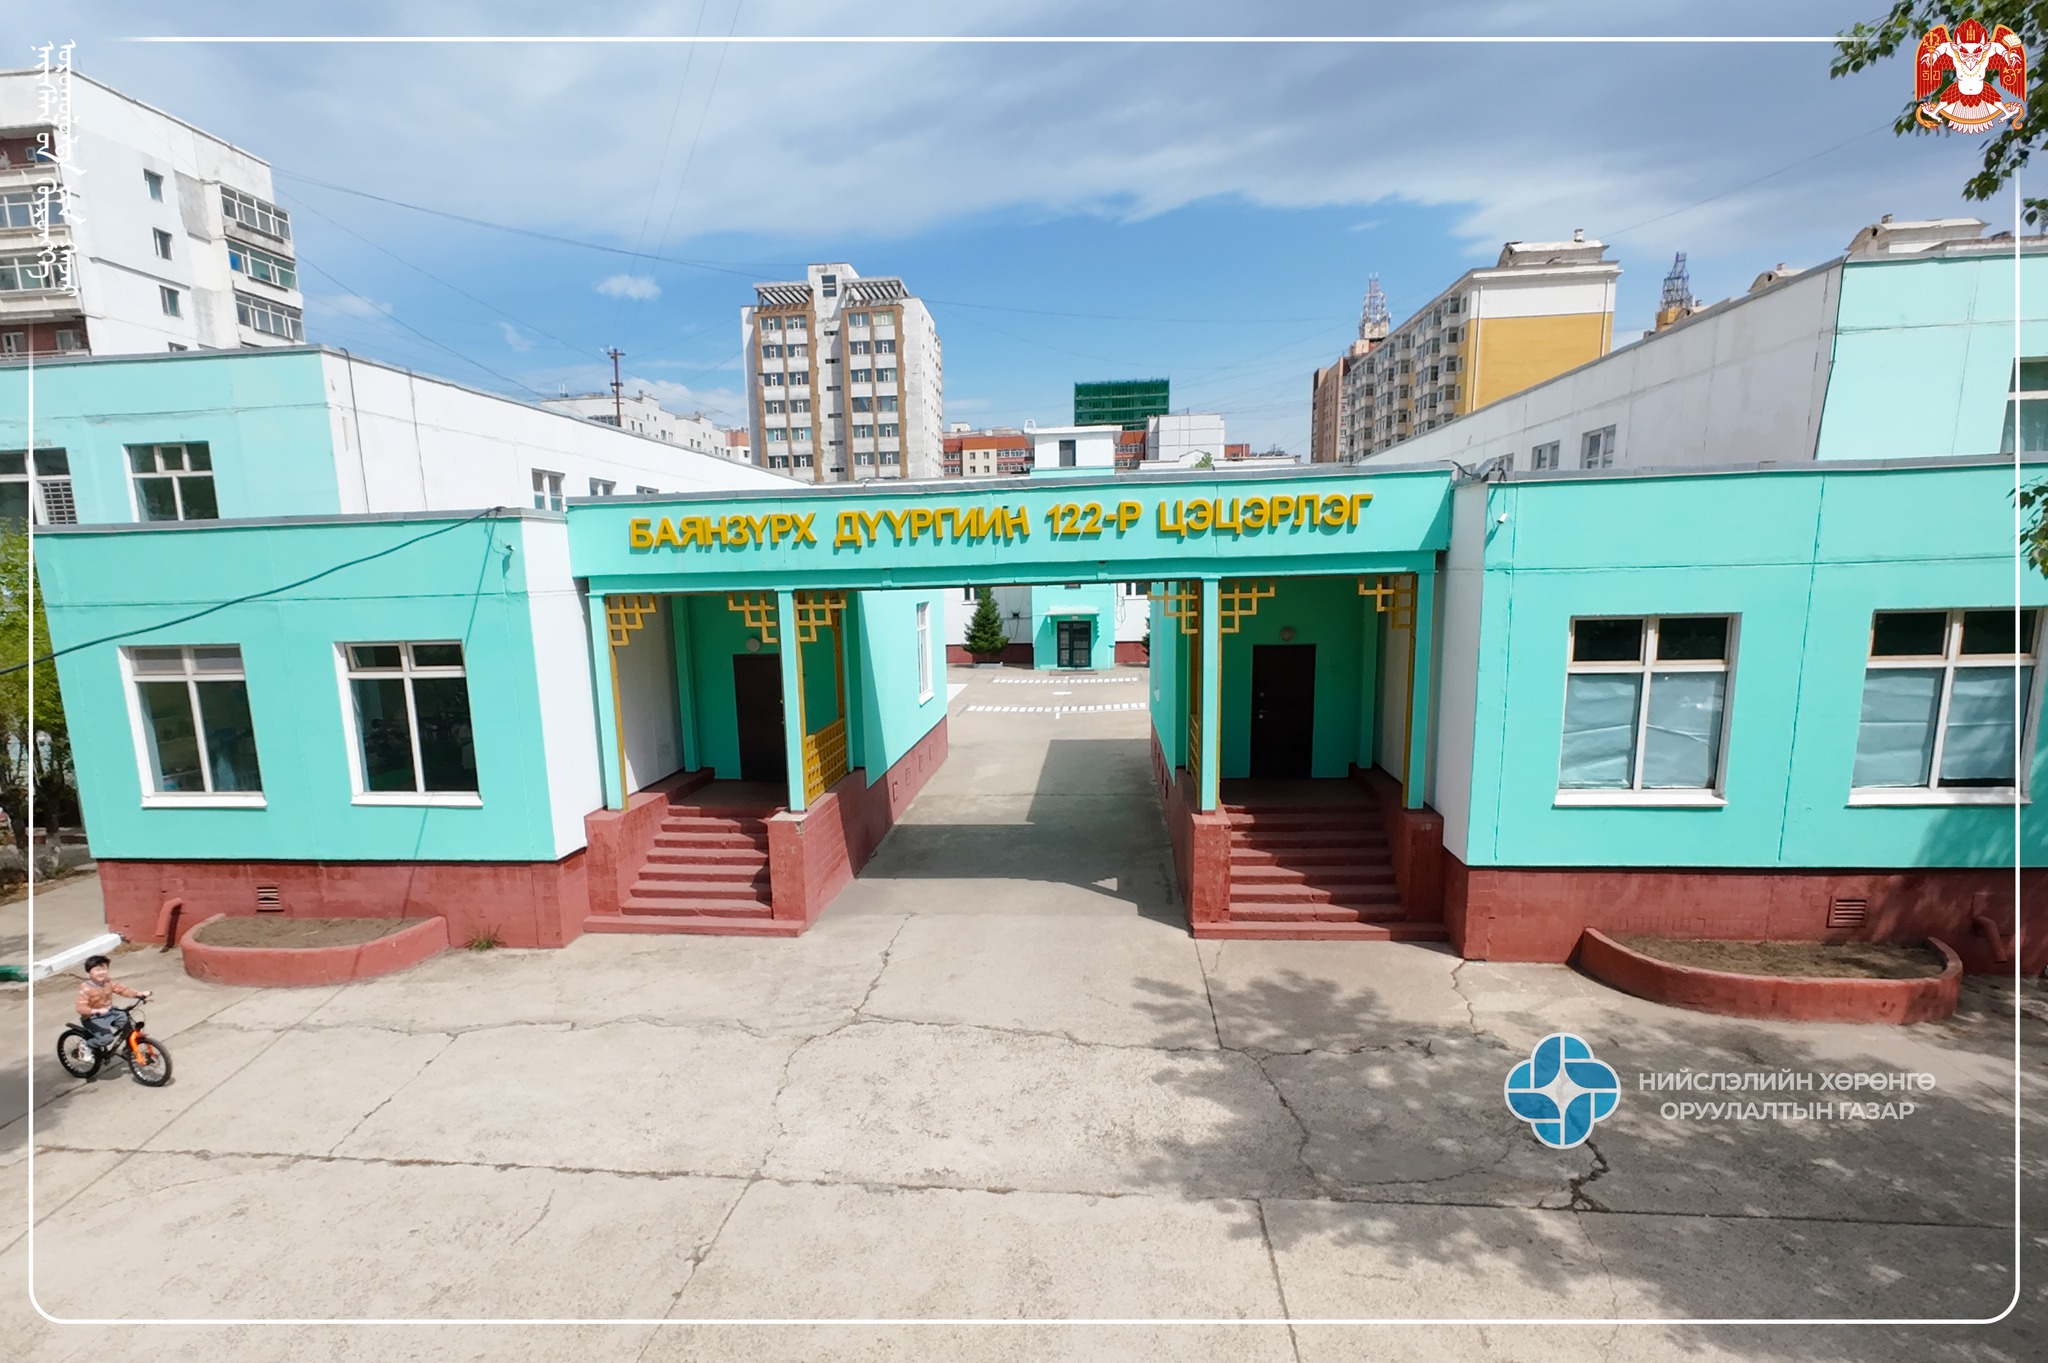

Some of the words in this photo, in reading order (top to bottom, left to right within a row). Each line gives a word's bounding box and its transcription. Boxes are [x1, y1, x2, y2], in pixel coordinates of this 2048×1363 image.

[629, 512, 817, 548] БАЯНЗҮРХ
[1047, 501, 1143, 534] 122-Р
[1159, 493, 1374, 537] ЦЭЦЭРЛЭГ
